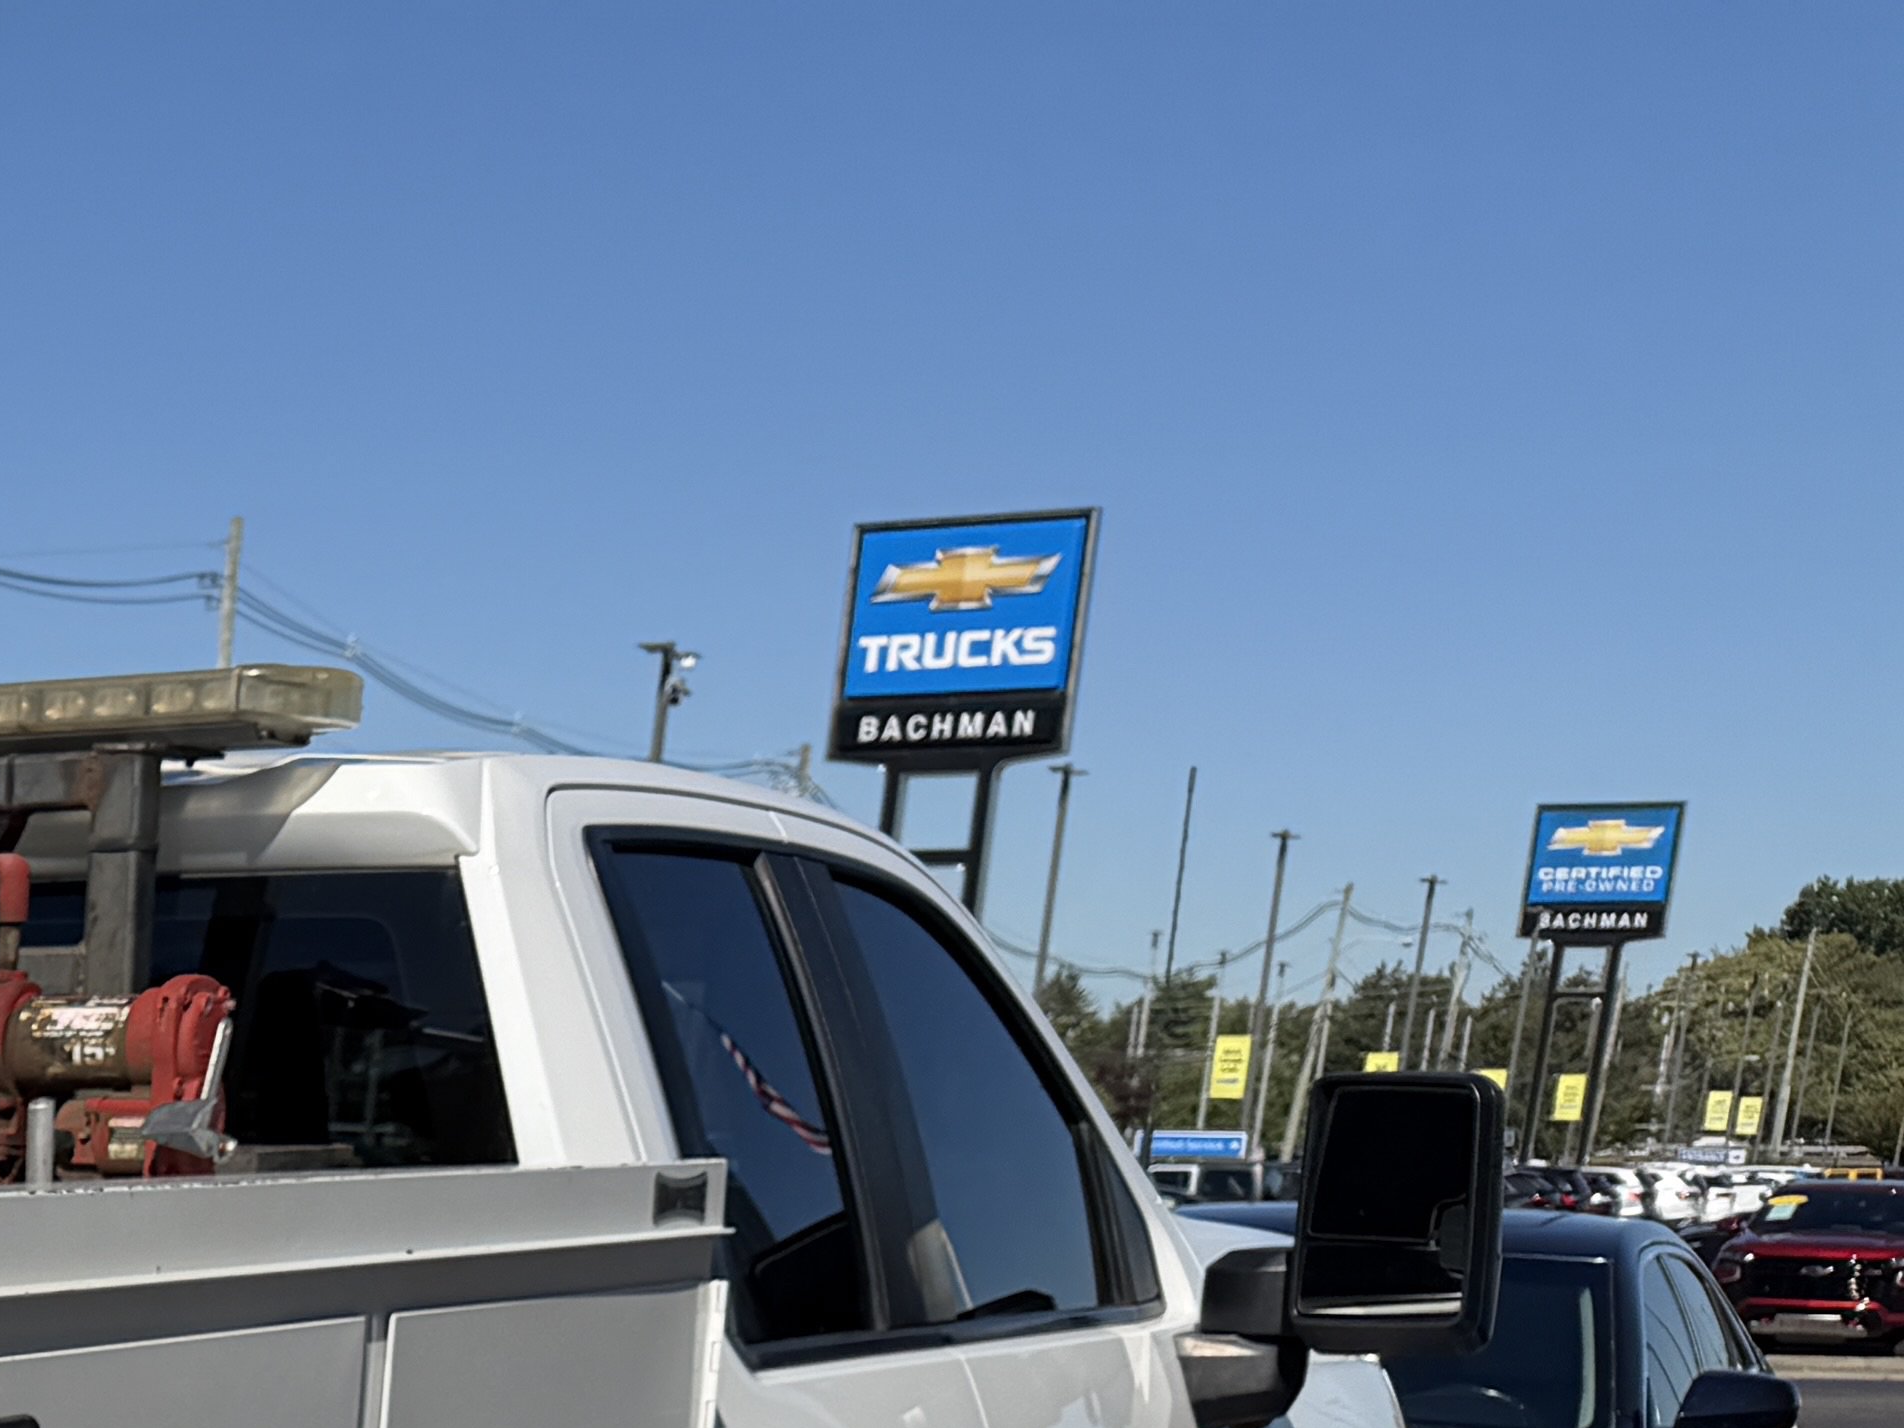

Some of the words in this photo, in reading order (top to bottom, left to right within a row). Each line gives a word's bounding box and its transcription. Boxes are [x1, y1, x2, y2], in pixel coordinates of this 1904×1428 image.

[858, 626, 1057, 673] TRUCKS
[857, 708, 1037, 743] BACHMAN
[1537, 865, 1663, 880] CERTIFIED
[1541, 878, 1654, 893] PRE-OWNED
[1538, 911, 1649, 930] BACHMAN
